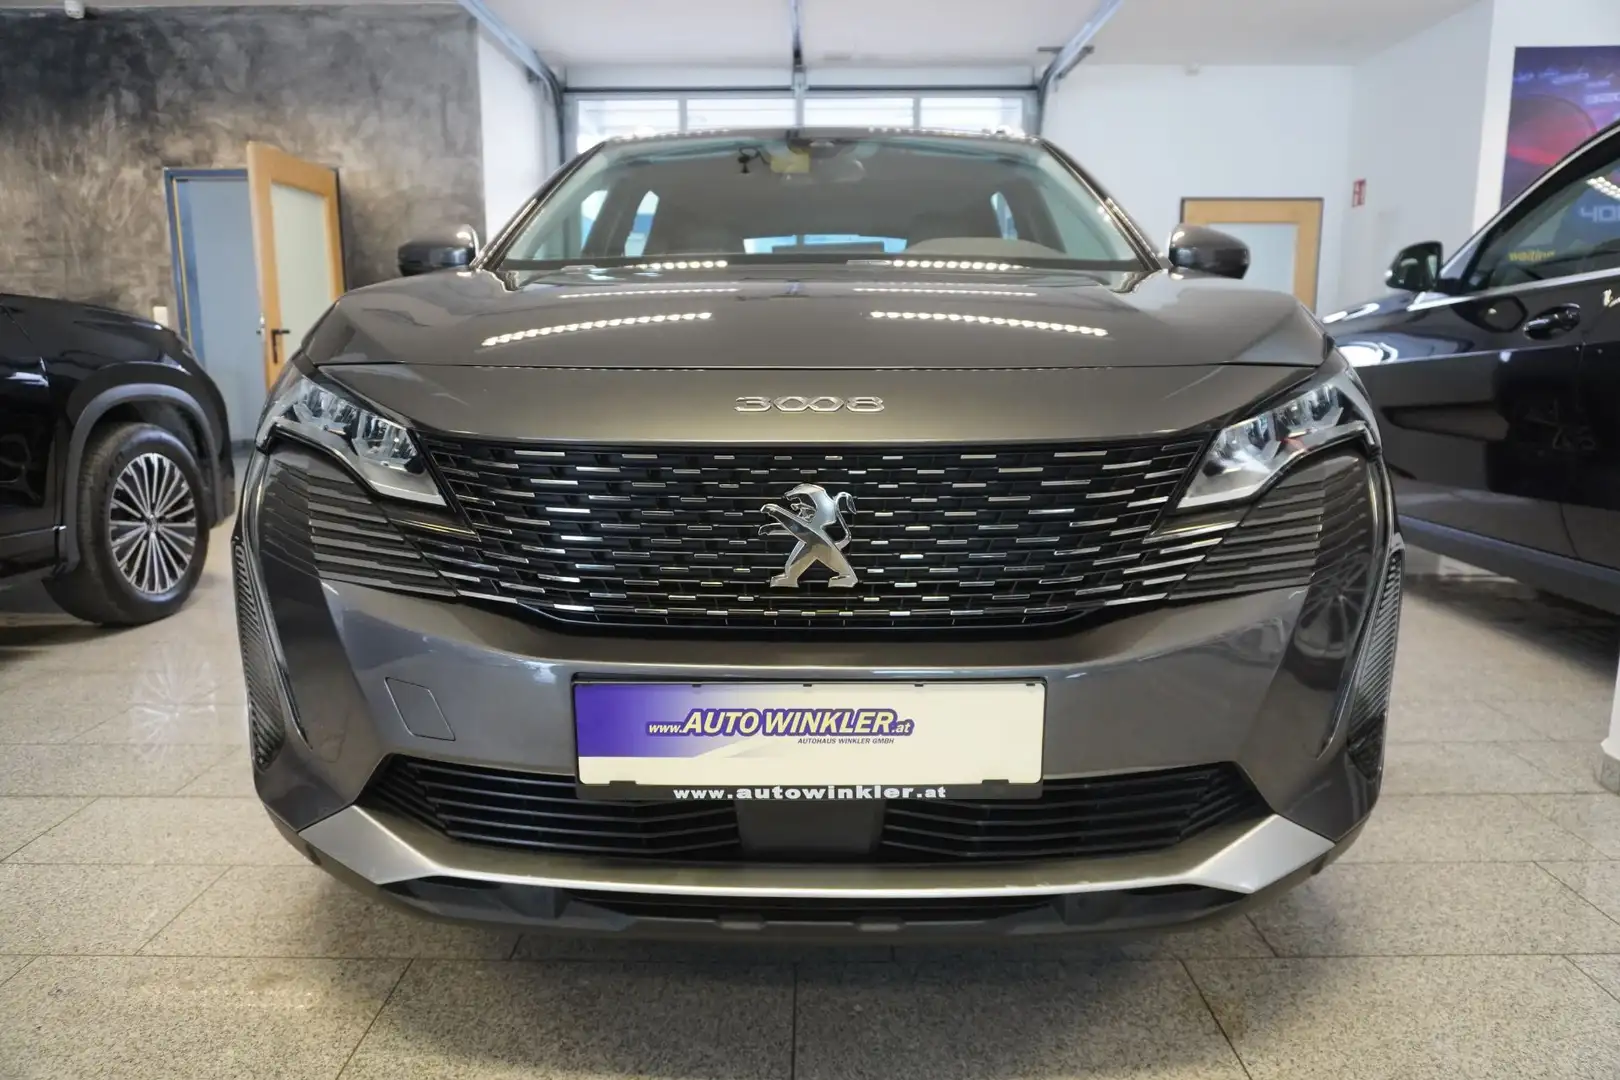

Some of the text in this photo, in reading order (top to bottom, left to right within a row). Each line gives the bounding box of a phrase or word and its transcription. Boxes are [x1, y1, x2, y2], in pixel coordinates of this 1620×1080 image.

[1579, 205, 1620, 223] 40
[734, 395, 886, 412] 3008
[797, 737, 895, 745] AUTOHAUS WINKLER GMBH
[673, 785, 946, 799] www.autowinkler.at
